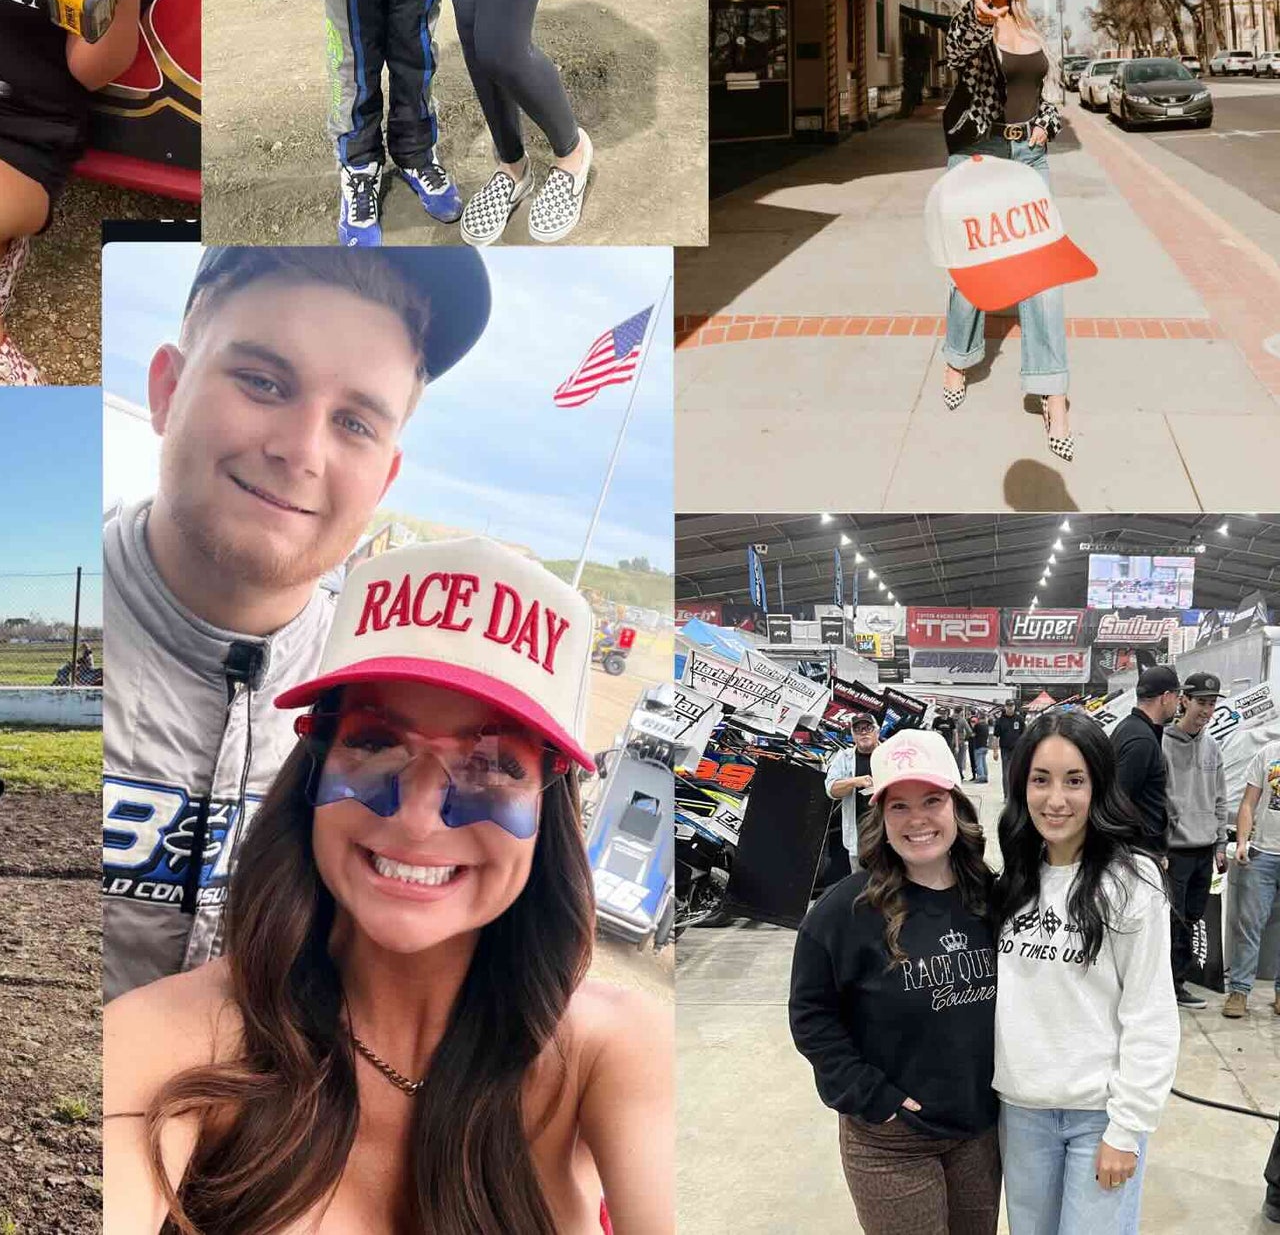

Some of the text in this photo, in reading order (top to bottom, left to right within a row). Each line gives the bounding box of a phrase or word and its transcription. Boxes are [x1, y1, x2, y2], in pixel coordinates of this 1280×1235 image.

[963, 198, 1051, 250] RACIN'
[354, 572, 569, 675] RACE DAY
[916, 618, 990, 642] TRD
[1013, 615, 1077, 640] Hyper
[1004, 652, 1084, 670] WHELEN
[694, 659, 781, 703] Harley Hollan
[1020, 942, 1058, 961] TIMES
[901, 955, 955, 991] RACE
[931, 984, 996, 1012] Couture
